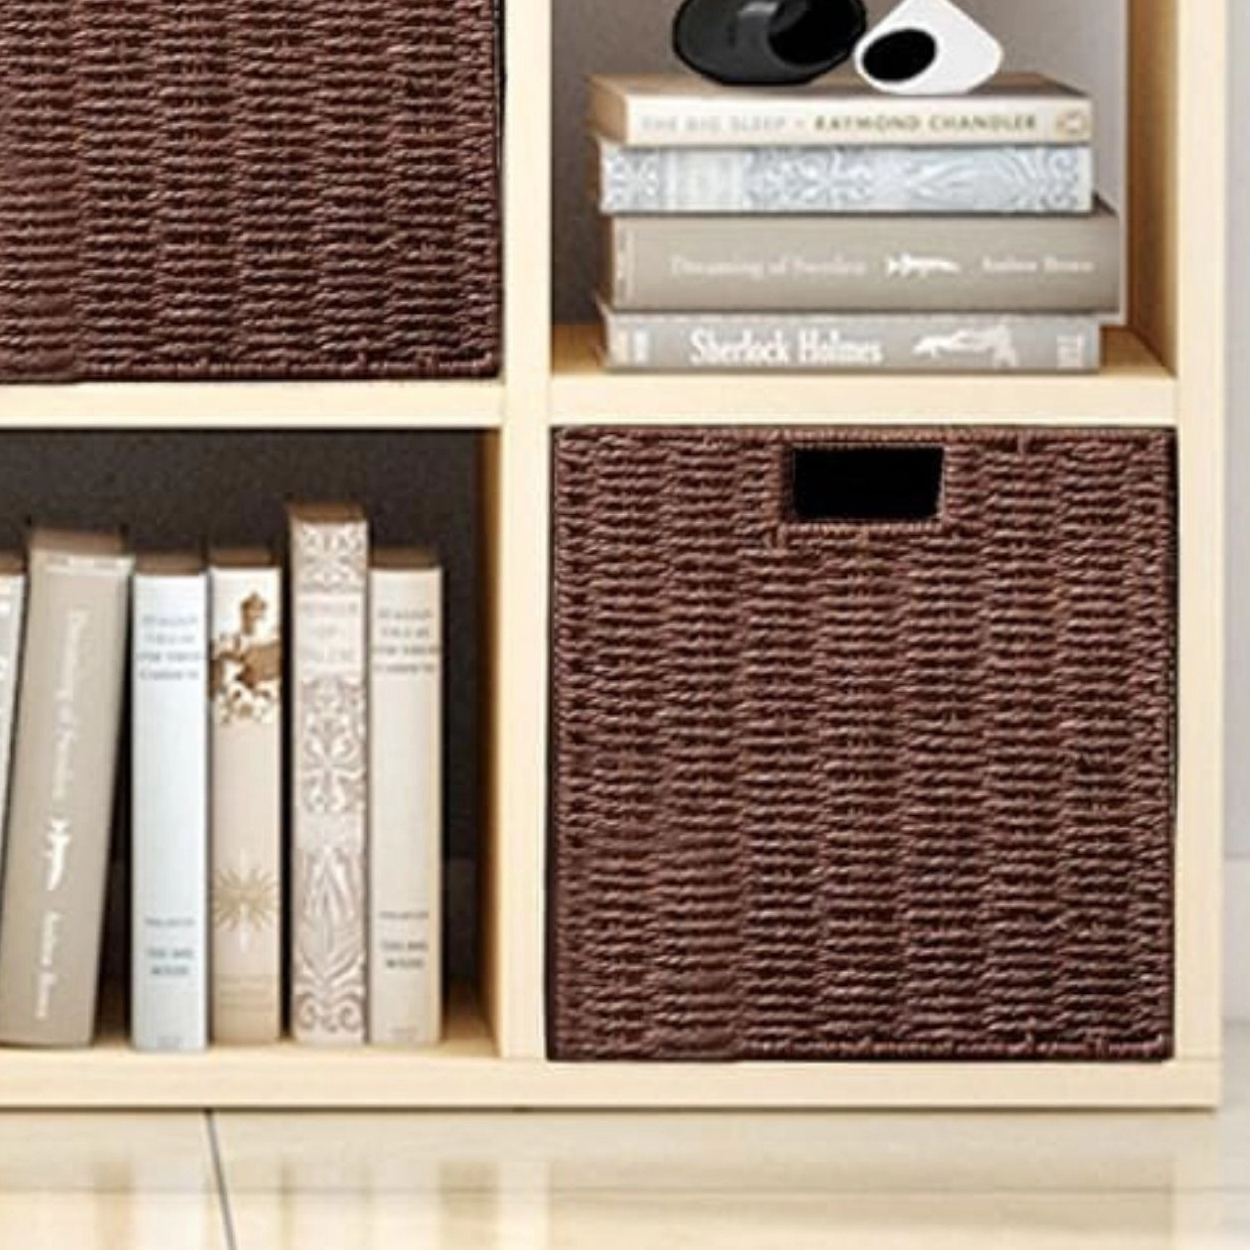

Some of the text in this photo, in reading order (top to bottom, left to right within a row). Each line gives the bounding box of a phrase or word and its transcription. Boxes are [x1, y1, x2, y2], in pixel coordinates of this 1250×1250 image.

[814, 114, 922, 133] RAYMOND
[927, 114, 1037, 133] CHANDLER
[690, 328, 883, 366] Sherlock Holmes
